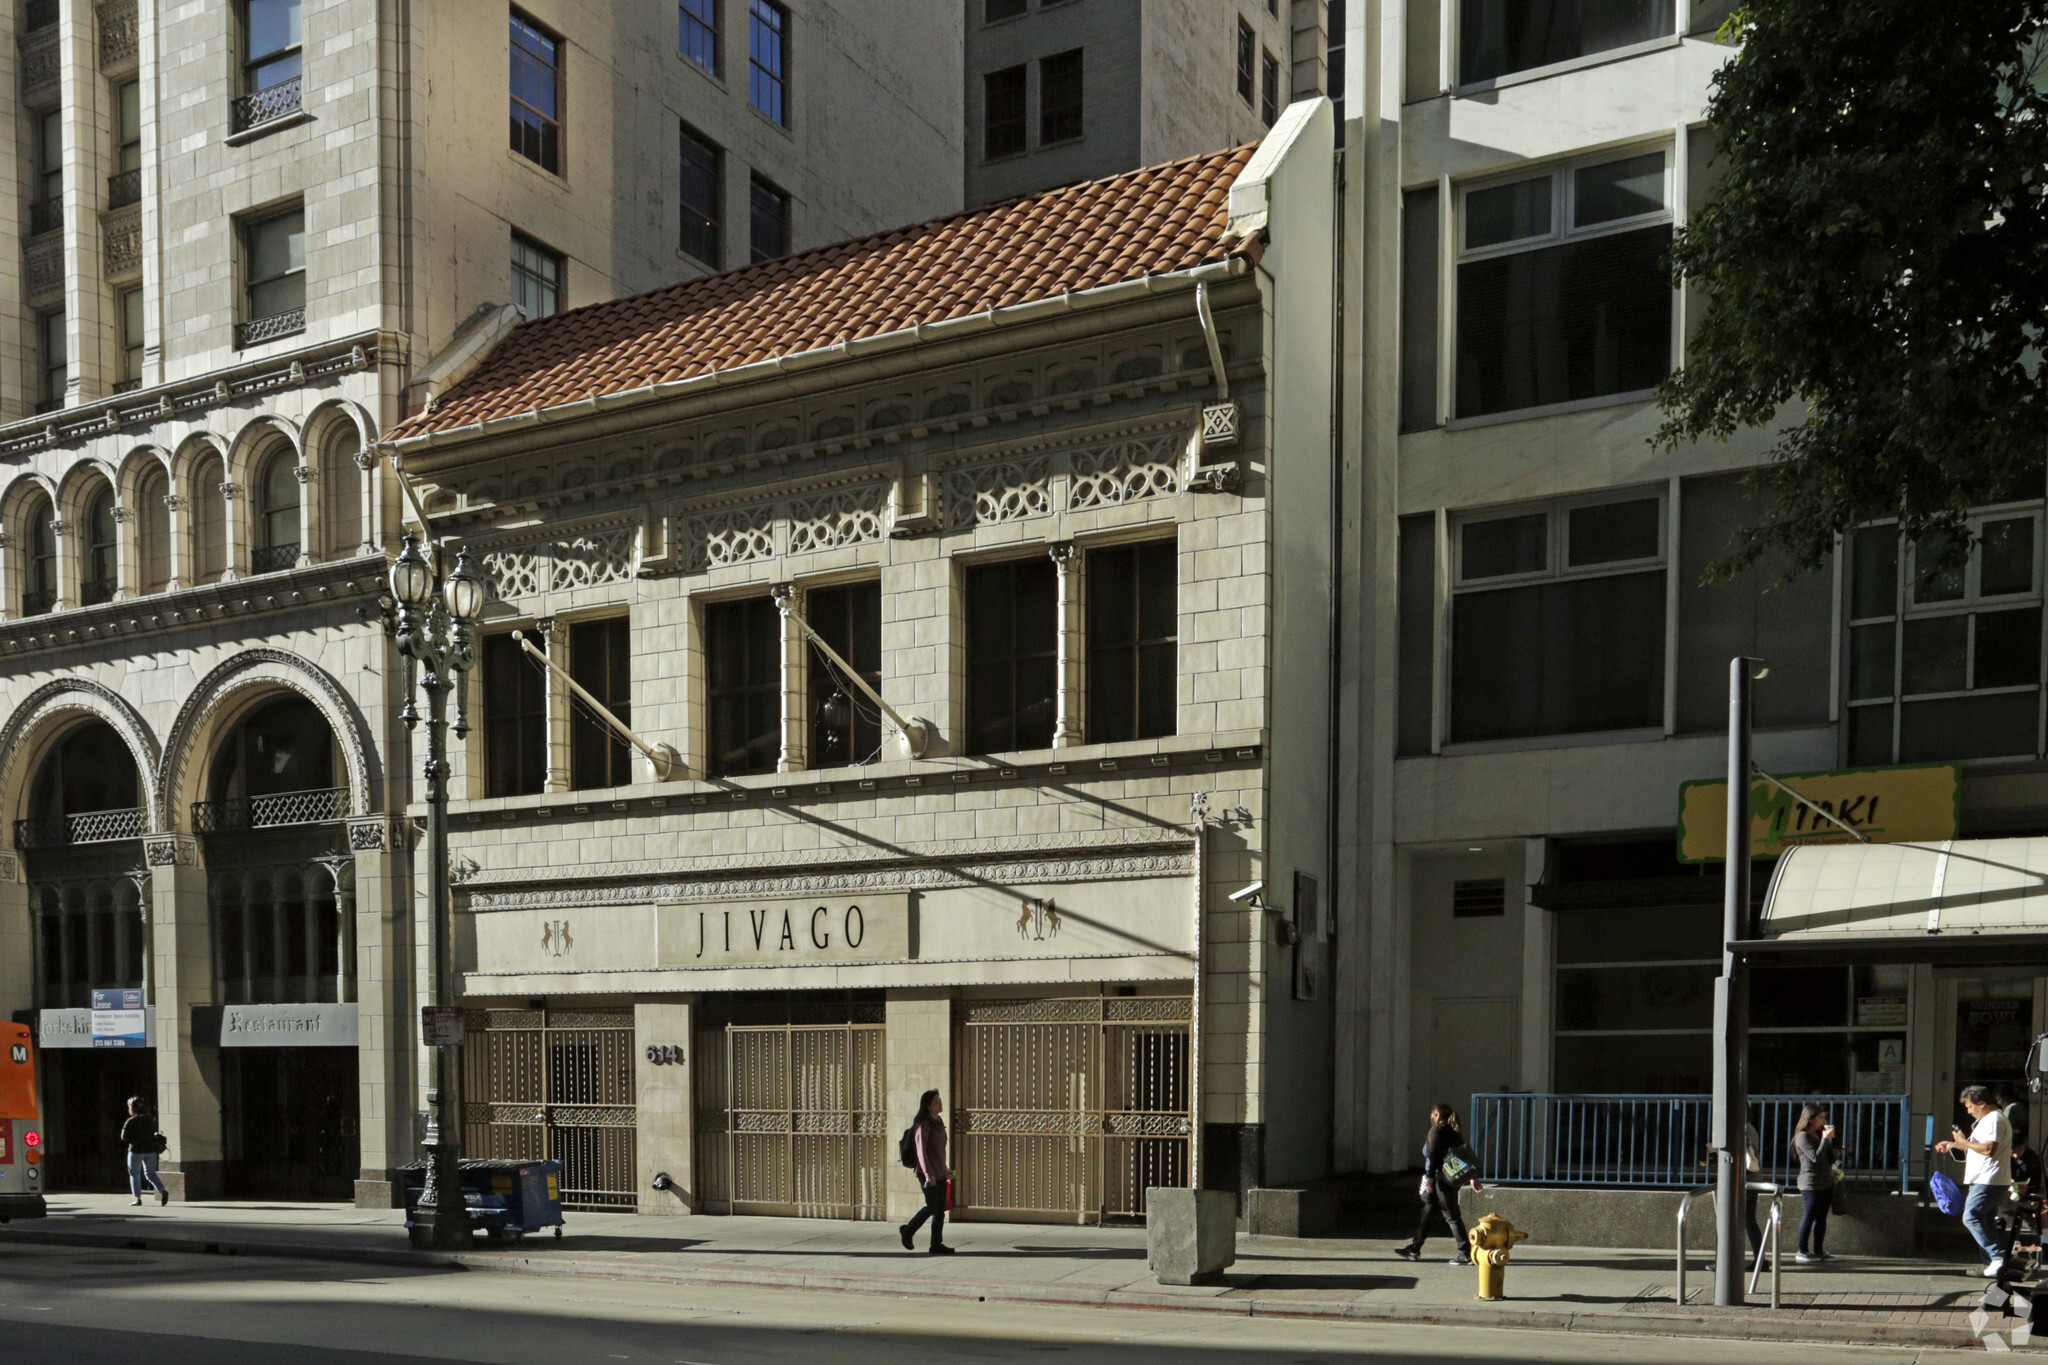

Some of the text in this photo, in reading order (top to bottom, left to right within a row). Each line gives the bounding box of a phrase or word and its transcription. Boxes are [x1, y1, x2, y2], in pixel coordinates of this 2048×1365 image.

[696, 905, 864, 958] JIVAGO
[94, 991, 105, 1001] For
[94, 1001, 112, 1009] Lease
[229, 1012, 321, 1033] Restaurant
[12, 1046, 27, 1061] M
[645, 1044, 678, 1062] 614
[1884, 1044, 1897, 1058] A
[1442, 1156, 1468, 1177] LA
